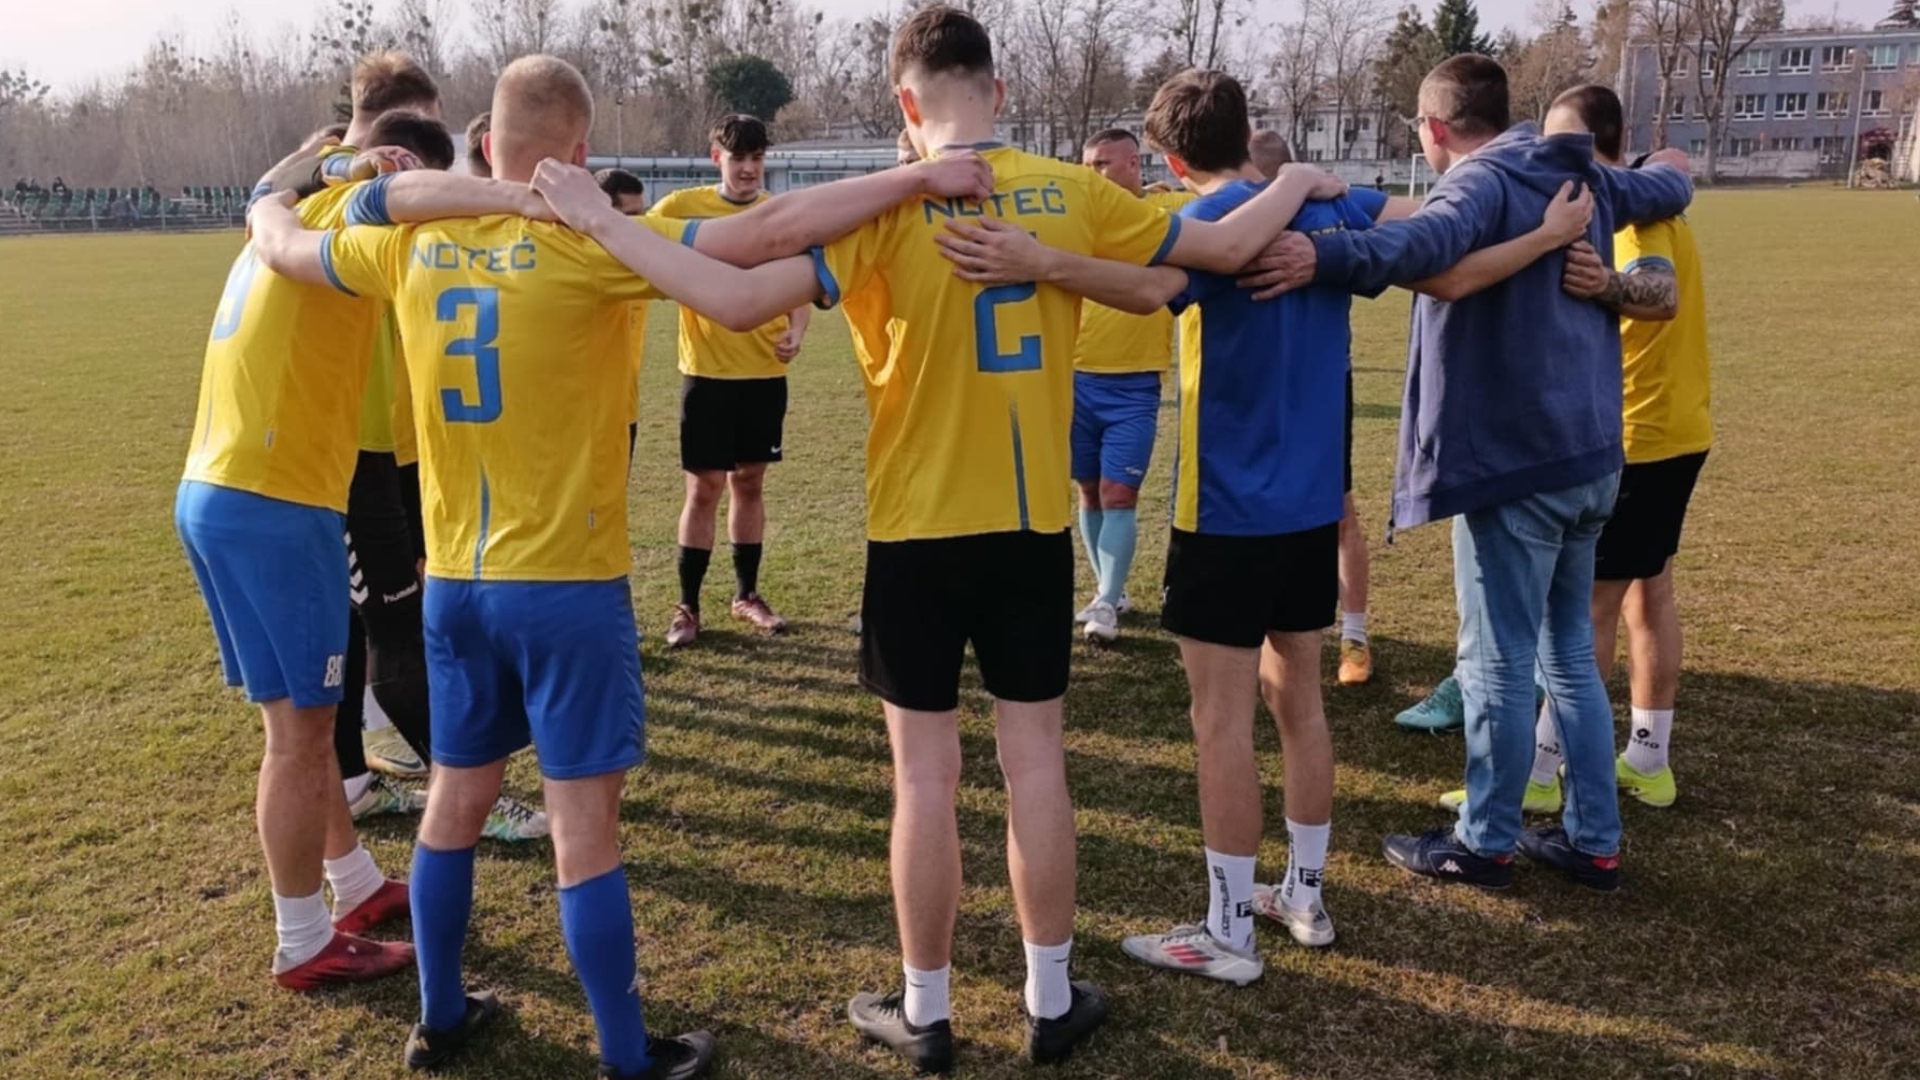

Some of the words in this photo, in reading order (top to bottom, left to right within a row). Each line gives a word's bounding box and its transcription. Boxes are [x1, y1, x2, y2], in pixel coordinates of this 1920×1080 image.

[923, 181, 1067, 225] NOTEĆ
[411, 235, 536, 273] NOTEĆ
[436, 287, 502, 423] 3
[974, 278, 1042, 372] 2
